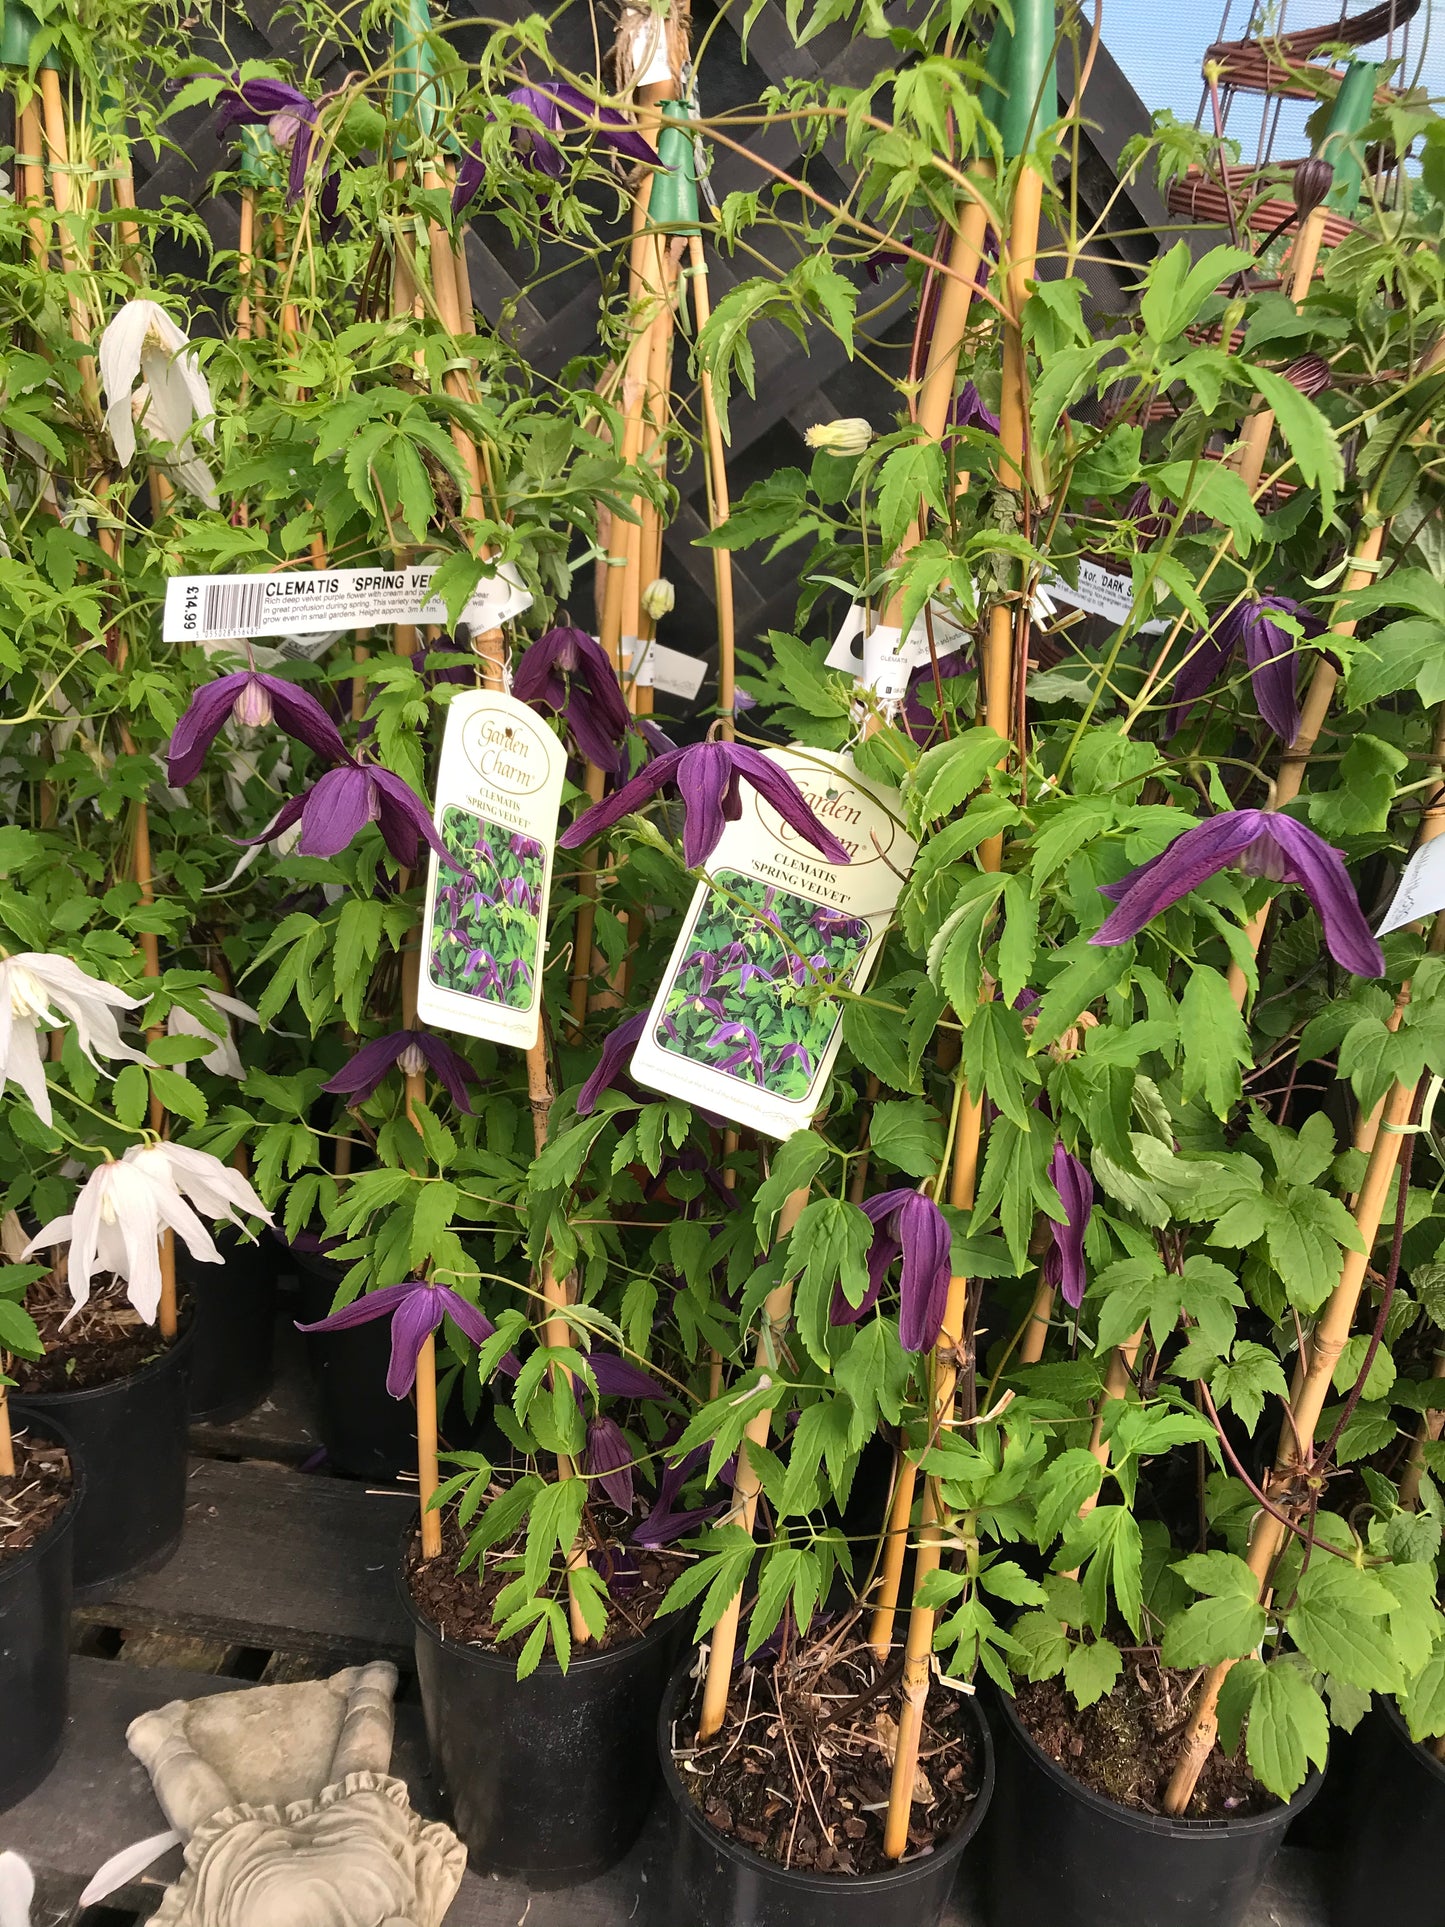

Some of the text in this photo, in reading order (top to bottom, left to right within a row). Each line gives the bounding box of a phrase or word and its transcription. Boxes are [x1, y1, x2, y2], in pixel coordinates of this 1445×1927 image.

[264, 596, 281, 605] Rich
[282, 595, 301, 606] deep
[302, 594, 322, 603] velvet
[323, 593, 345, 603] purple
[346, 591, 366, 600] flower
[367, 590, 381, 599] with
[382, 589, 404, 598] cream
[404, 588, 418, 597] and
[265, 578, 339, 597] CLEMATIS
[352, 574, 405, 592] 'SPRING
[183, 585, 200, 630] £14.99
[262, 616, 281, 625] grow
[282, 614, 300, 623] even
[300, 613, 308, 621] in
[308, 612, 328, 621] small
[358, 607, 381, 617] Height
[407, 605, 419, 613] 3m
[263, 606, 270, 614] in
[271, 606, 291, 616] great
[291, 603, 325, 614] profusion
[325, 601, 348, 612] during
[373, 598, 387, 607] This
[387, 597, 410, 607] variety
[478, 720, 529, 758] Garden
[480, 749, 531, 787] Charm
[479, 787, 521, 812] CLEMATIS
[751, 858, 851, 905] 'SPRING VELVET'
[774, 852, 838, 884] CLEMATIS
